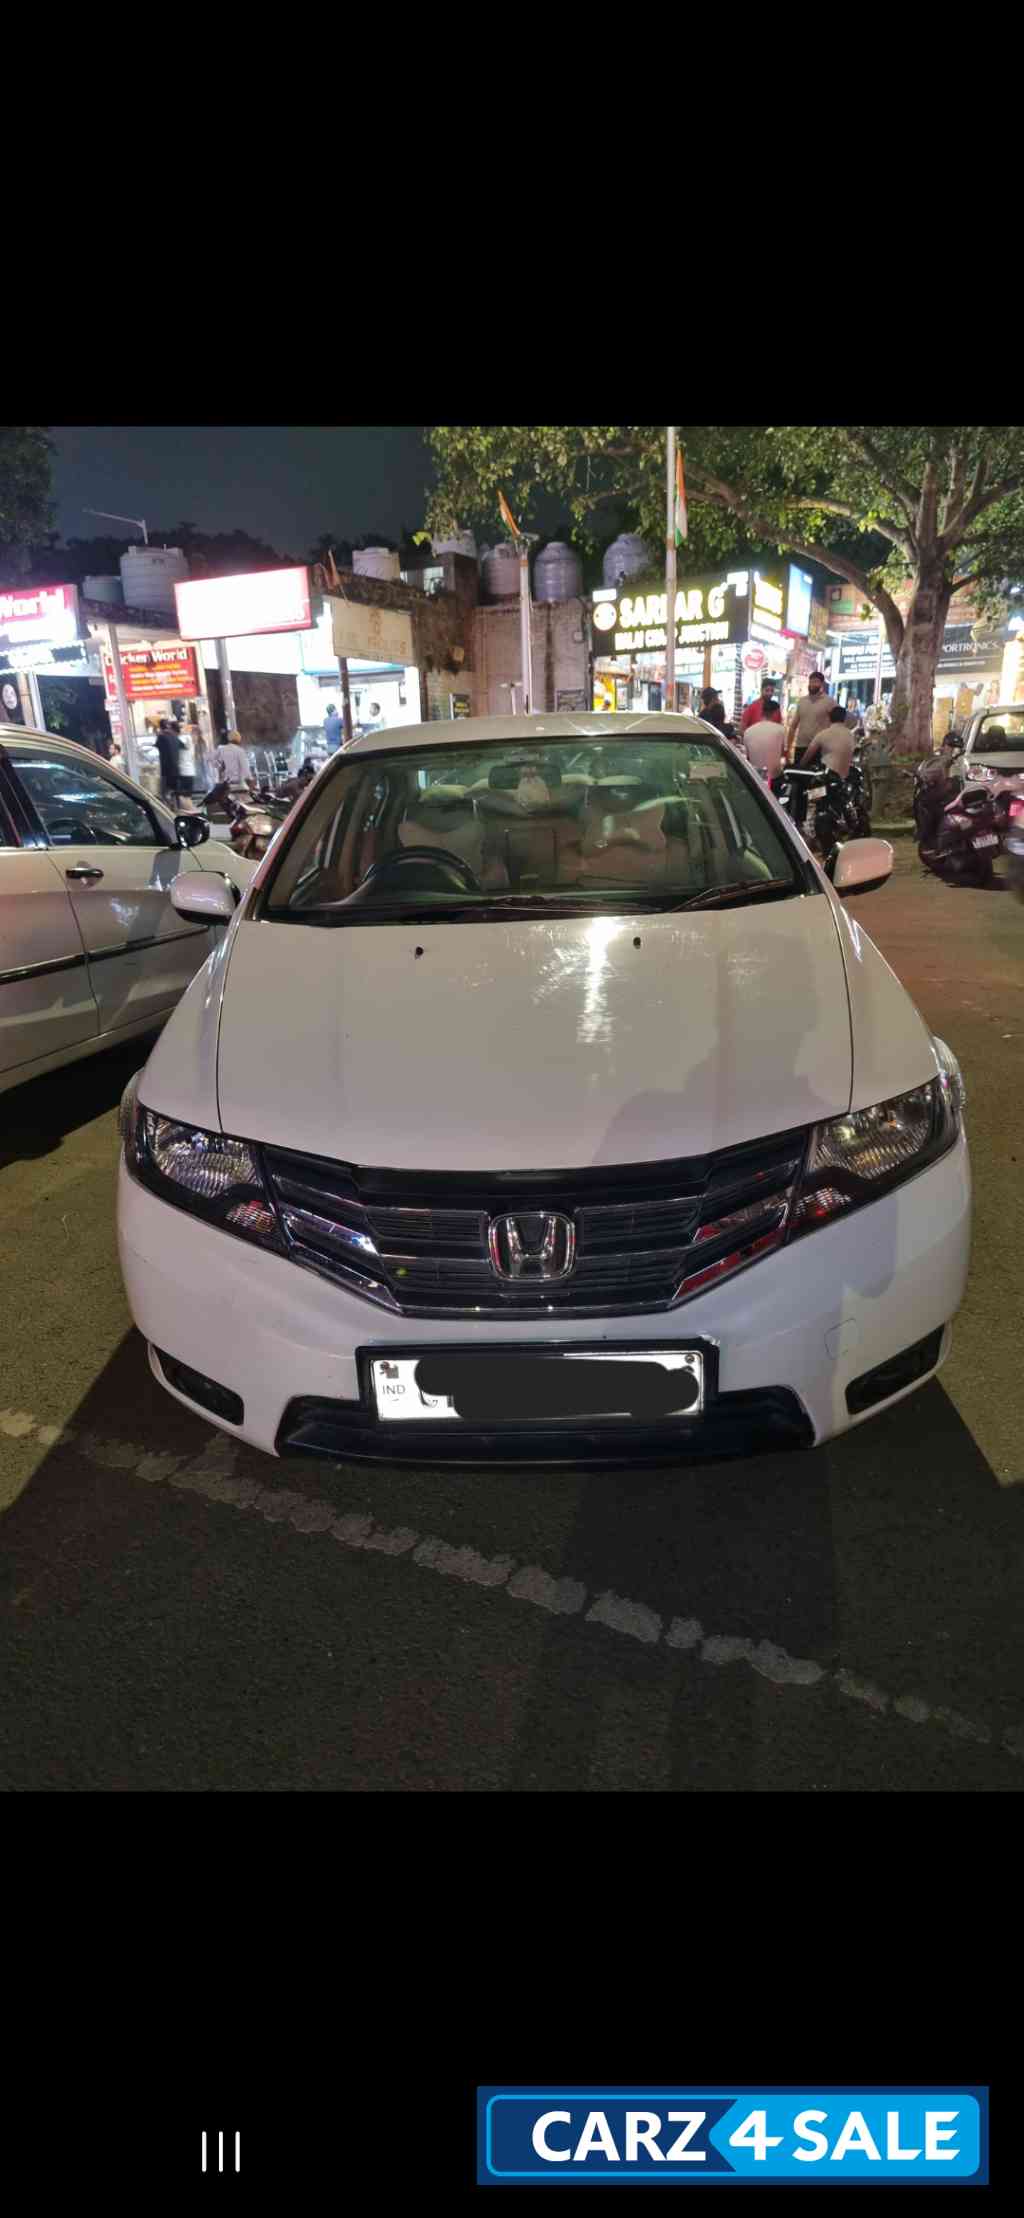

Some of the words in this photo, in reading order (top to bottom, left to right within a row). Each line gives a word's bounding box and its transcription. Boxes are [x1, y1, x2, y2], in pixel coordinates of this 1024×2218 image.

[104, 652, 149, 666] Cicken
[152, 647, 188, 662] World
[382, 1384, 406, 1396] IND
